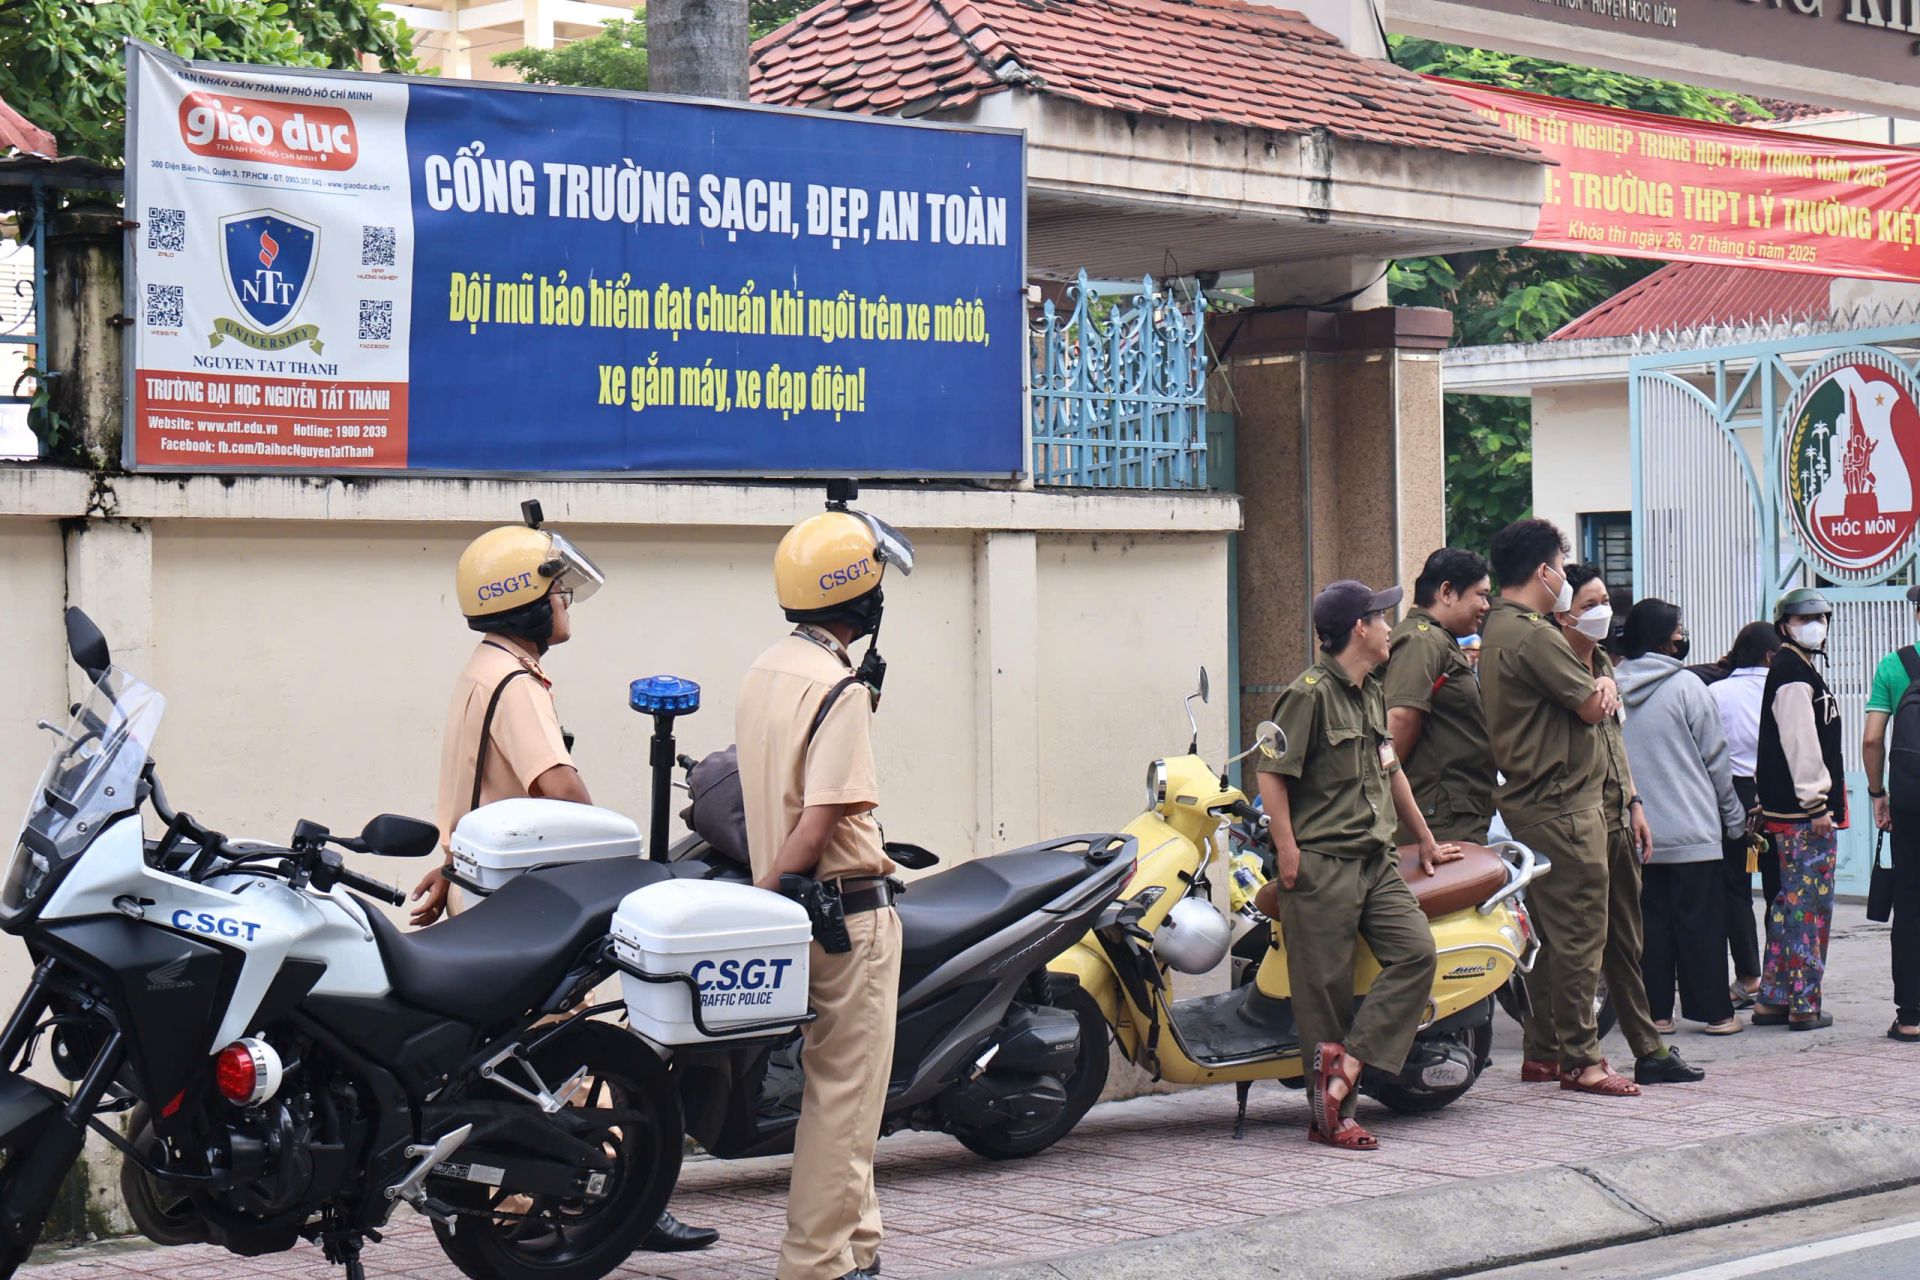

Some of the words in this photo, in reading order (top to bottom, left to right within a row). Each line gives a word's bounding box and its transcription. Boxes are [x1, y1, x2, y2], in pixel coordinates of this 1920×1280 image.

[1654, 2, 1677, 28] MÔN
[177, 71, 197, 83] BAN
[255, 83, 289, 96] THÀNH
[330, 88, 346, 99] CHÍ
[347, 90, 373, 101] MINH
[187, 98, 274, 147] giáo
[283, 113, 351, 162] dục
[1504, 112, 1533, 140] THI
[1537, 110, 1569, 146] TỐT
[1572, 122, 1634, 158] NGHIỆP
[1638, 131, 1692, 164] TRUNG
[1695, 139, 1727, 171] HỌC
[1731, 140, 1761, 172] PHỔ
[1765, 149, 1814, 179] THÔNG
[1816, 154, 1850, 184] NĂM
[1852, 163, 1888, 189] 2025
[151, 160, 163, 169] 300
[165, 161, 180, 172] Điện
[181, 162, 196, 173] Biên
[212, 167, 231, 178] Quận
[233, 169, 240, 178] 3,
[242, 170, 269, 181] TP.HCM
[424, 140, 535, 216] CỔNG
[543, 158, 690, 226] TRƯỜNG
[699, 173, 799, 242] SẠCH,
[806, 184, 870, 250] ĐẸP,
[876, 190, 919, 241] AN
[926, 185, 1007, 246] TOÀN
[1568, 169, 1674, 218] TRƯỜNG
[1681, 185, 1742, 226] THPT
[1748, 188, 1775, 229] LÝ
[1782, 195, 1873, 241] THƯỜNG
[1878, 206, 1920, 251] KIỆT
[1568, 220, 1604, 242] Khóa
[1608, 226, 1627, 243] thi
[1630, 229, 1663, 253] ngày
[1666, 231, 1685, 252] 26,
[1689, 234, 1705, 250] 27
[1708, 237, 1744, 260] tháng
[1748, 240, 1756, 257] 6
[1758, 241, 1785, 260] năm
[1788, 244, 1817, 263] 2025
[242, 269, 294, 306] NTT
[449, 271, 492, 335] Đội
[495, 272, 534, 325] mũ
[539, 269, 585, 327] bảo
[590, 272, 649, 330] hiểm
[654, 282, 692, 342] đạt
[696, 279, 766, 335] chuẩn
[770, 288, 804, 336] khi
[808, 289, 856, 343] ngồi
[859, 294, 903, 340] trên
[906, 303, 930, 341] xe
[934, 298, 990, 347] môtô,
[224, 321, 309, 349] UNIVERSITY
[193, 355, 255, 371] NGUYEN
[257, 359, 287, 374] TAT
[288, 361, 338, 376] THANH
[145, 376, 204, 403] TRƯỜNG
[207, 382, 231, 409] ĐẠI
[234, 383, 261, 409] HỌC
[264, 382, 317, 409] NGUYỄN
[320, 383, 345, 410] TẤT
[348, 386, 390, 411] THÀNH
[598, 364, 627, 405] xe
[631, 351, 675, 412] gắn
[679, 358, 731, 413] máy,
[735, 367, 762, 409] xe
[765, 363, 807, 421] đạp
[811, 365, 866, 422] điện!
[148, 415, 194, 431] Website:
[197, 420, 278, 435] www.ntt.edu.vn
[293, 423, 333, 438] Hotline:
[336, 425, 360, 438] 1900
[362, 425, 387, 438] 2039
[161, 437, 215, 453] Facebook:
[218, 440, 375, 459] fb.com/DaihocNguyenTatThanh
[1831, 519, 1861, 537] HÓC
[1865, 517, 1896, 536] MÔN
[478, 571, 532, 601] CSGT
[819, 557, 870, 591] CSGT
[690, 958, 793, 992] C.S.G.T
[738, 992, 773, 1005] POLICE
